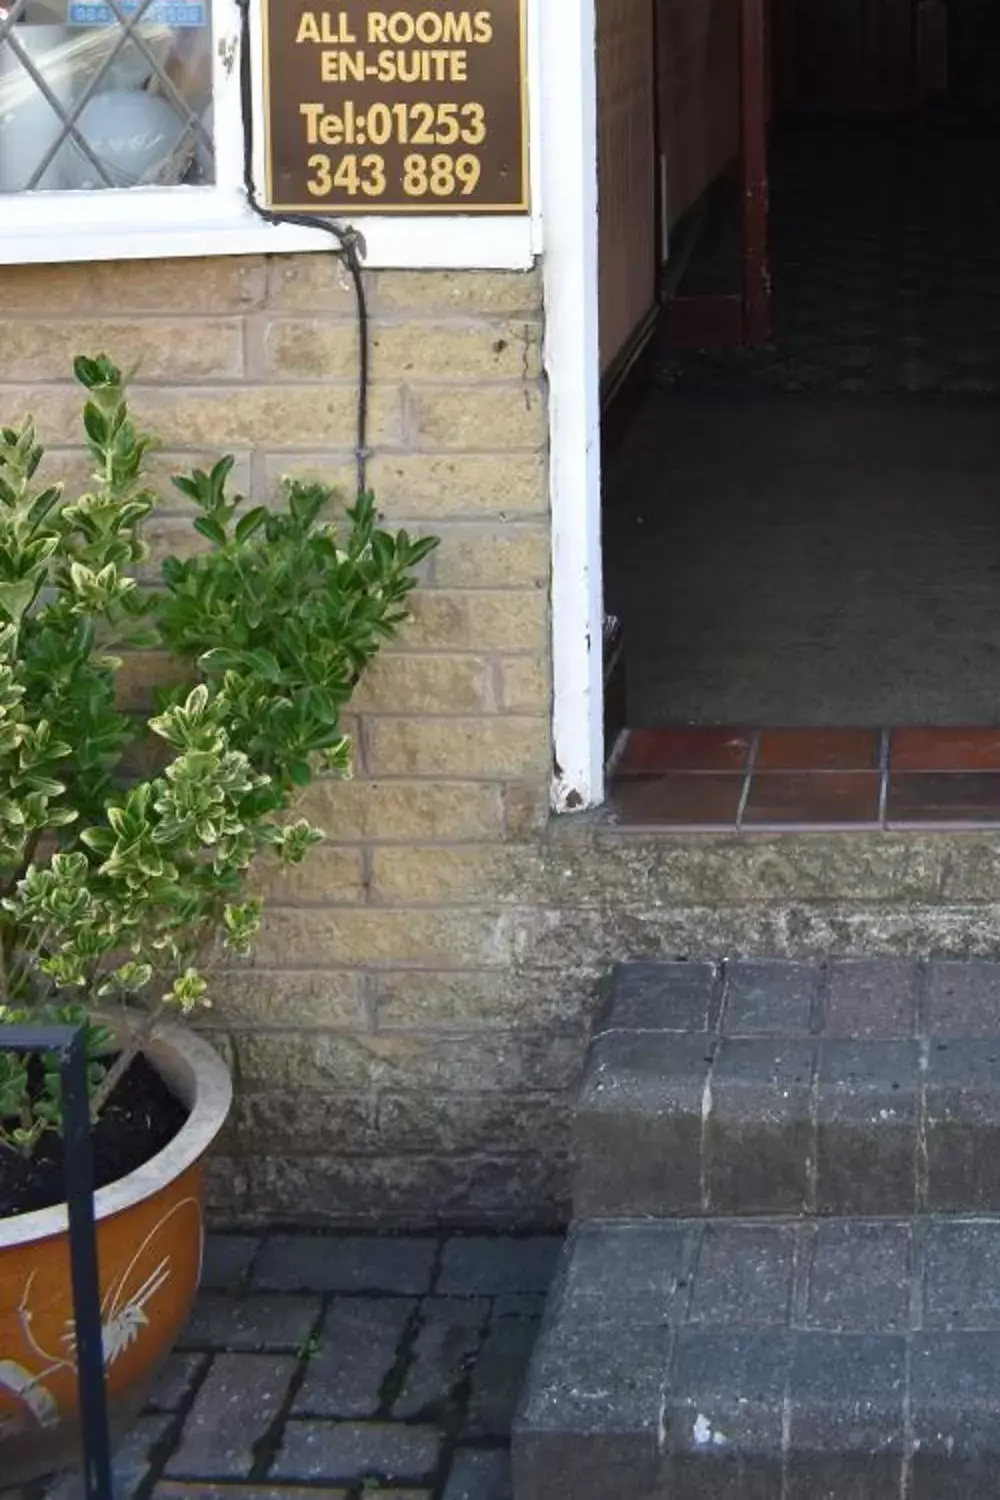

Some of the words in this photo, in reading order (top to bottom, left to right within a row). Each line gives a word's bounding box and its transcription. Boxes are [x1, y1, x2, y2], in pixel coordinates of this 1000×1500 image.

[296, 12, 356, 43] ALL
[368, 12, 492, 44] ROOMS
[321, 50, 467, 82] EN-SUITE
[300, 102, 486, 144] Tel:01253
[307, 155, 386, 196] 343
[402, 154, 480, 196] 889
